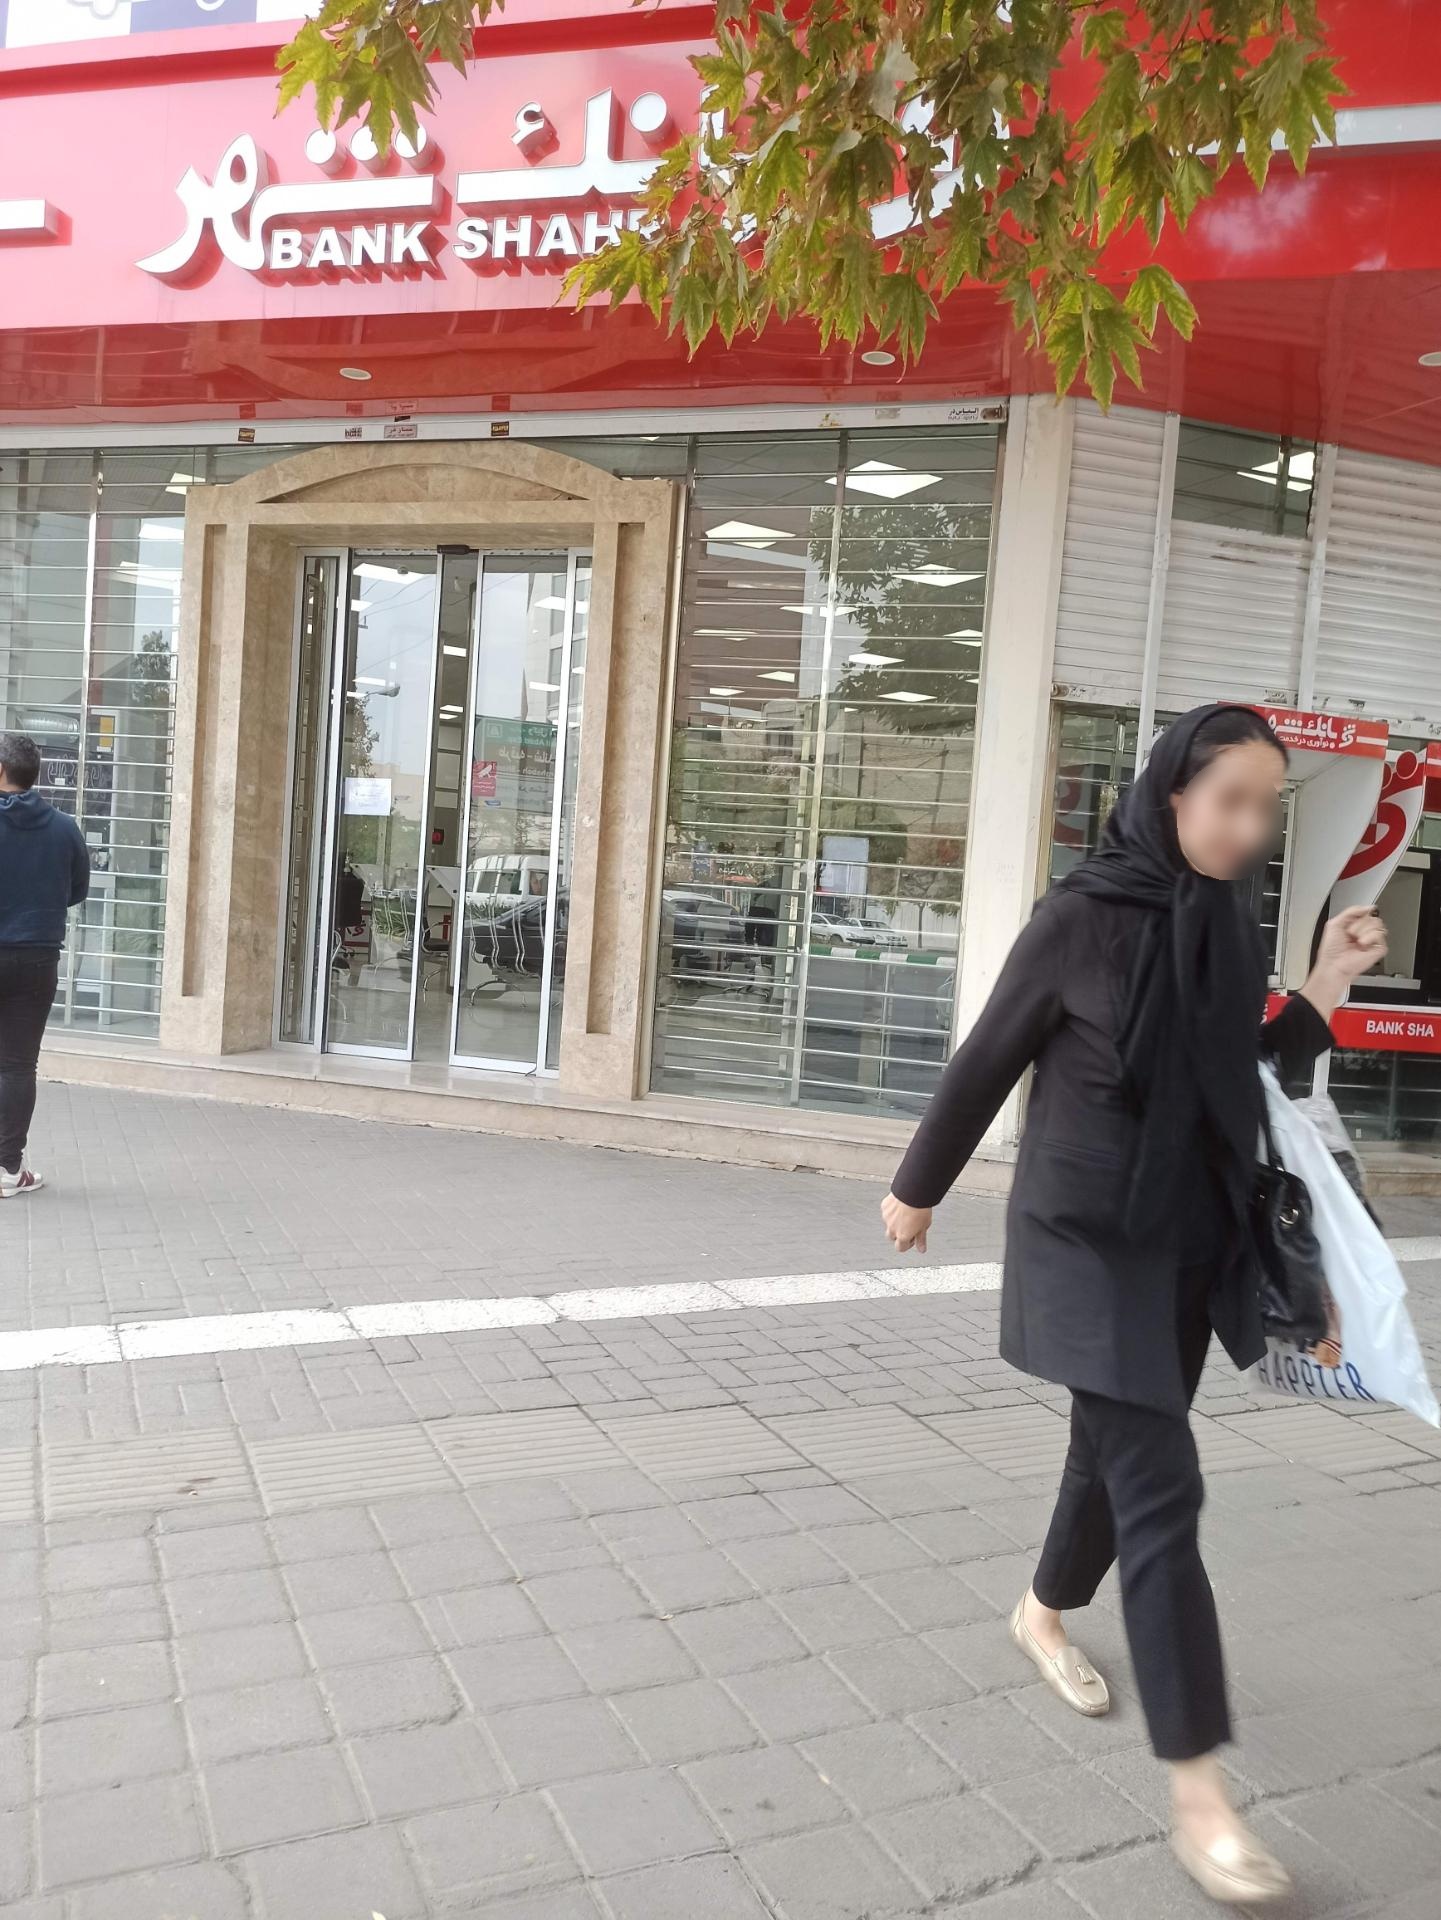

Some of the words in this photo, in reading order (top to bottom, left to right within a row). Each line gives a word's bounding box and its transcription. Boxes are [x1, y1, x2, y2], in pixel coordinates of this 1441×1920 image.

[457, 84, 757, 243] انک
[133, 123, 434, 271] شهر
[270, 220, 434, 270] BANK
[1268, 713, 1301, 737] شه
[1366, 1020, 1404, 1035] BANK
[1406, 1021, 1435, 1037] SHA
